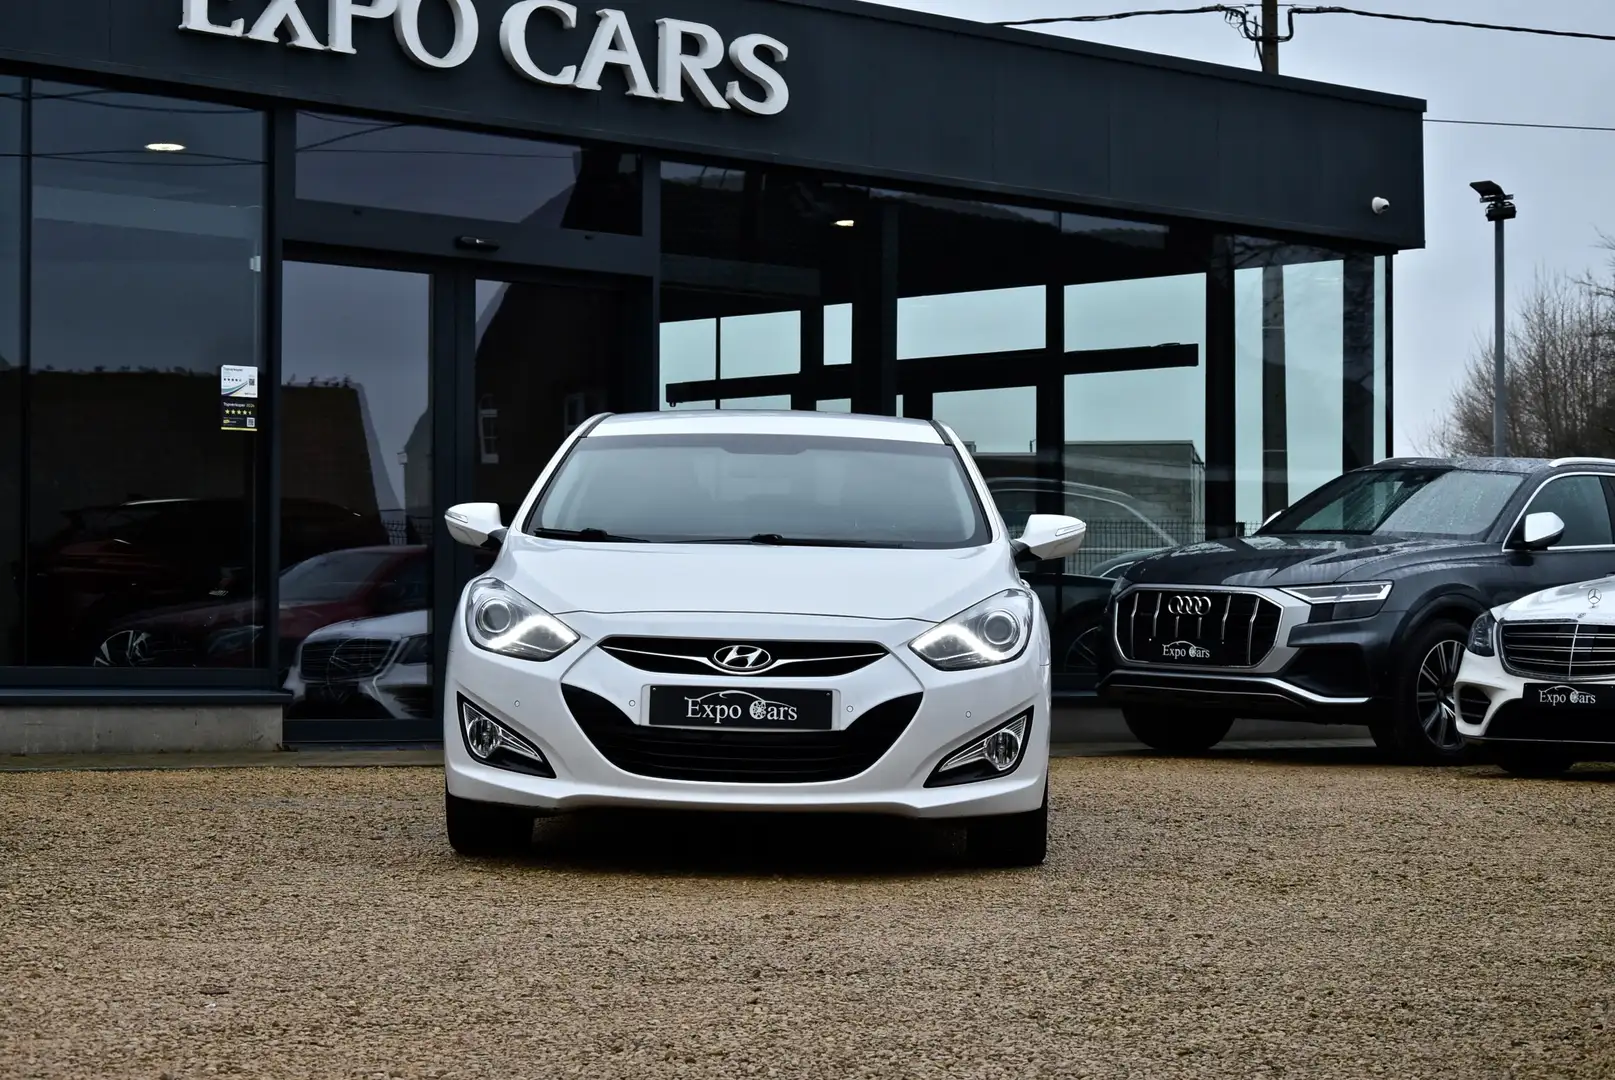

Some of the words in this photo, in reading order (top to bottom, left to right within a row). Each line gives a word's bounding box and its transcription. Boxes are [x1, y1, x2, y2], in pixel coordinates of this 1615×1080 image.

[500, 0, 789, 115] CARS
[1162, 645, 1187, 659] Expo
[1189, 646, 1210, 658] Cars
[1539, 690, 1566, 706] Expo
[1569, 691, 1596, 704] Cars
[685, 697, 742, 724] Expo
[749, 700, 798, 721] Cars
